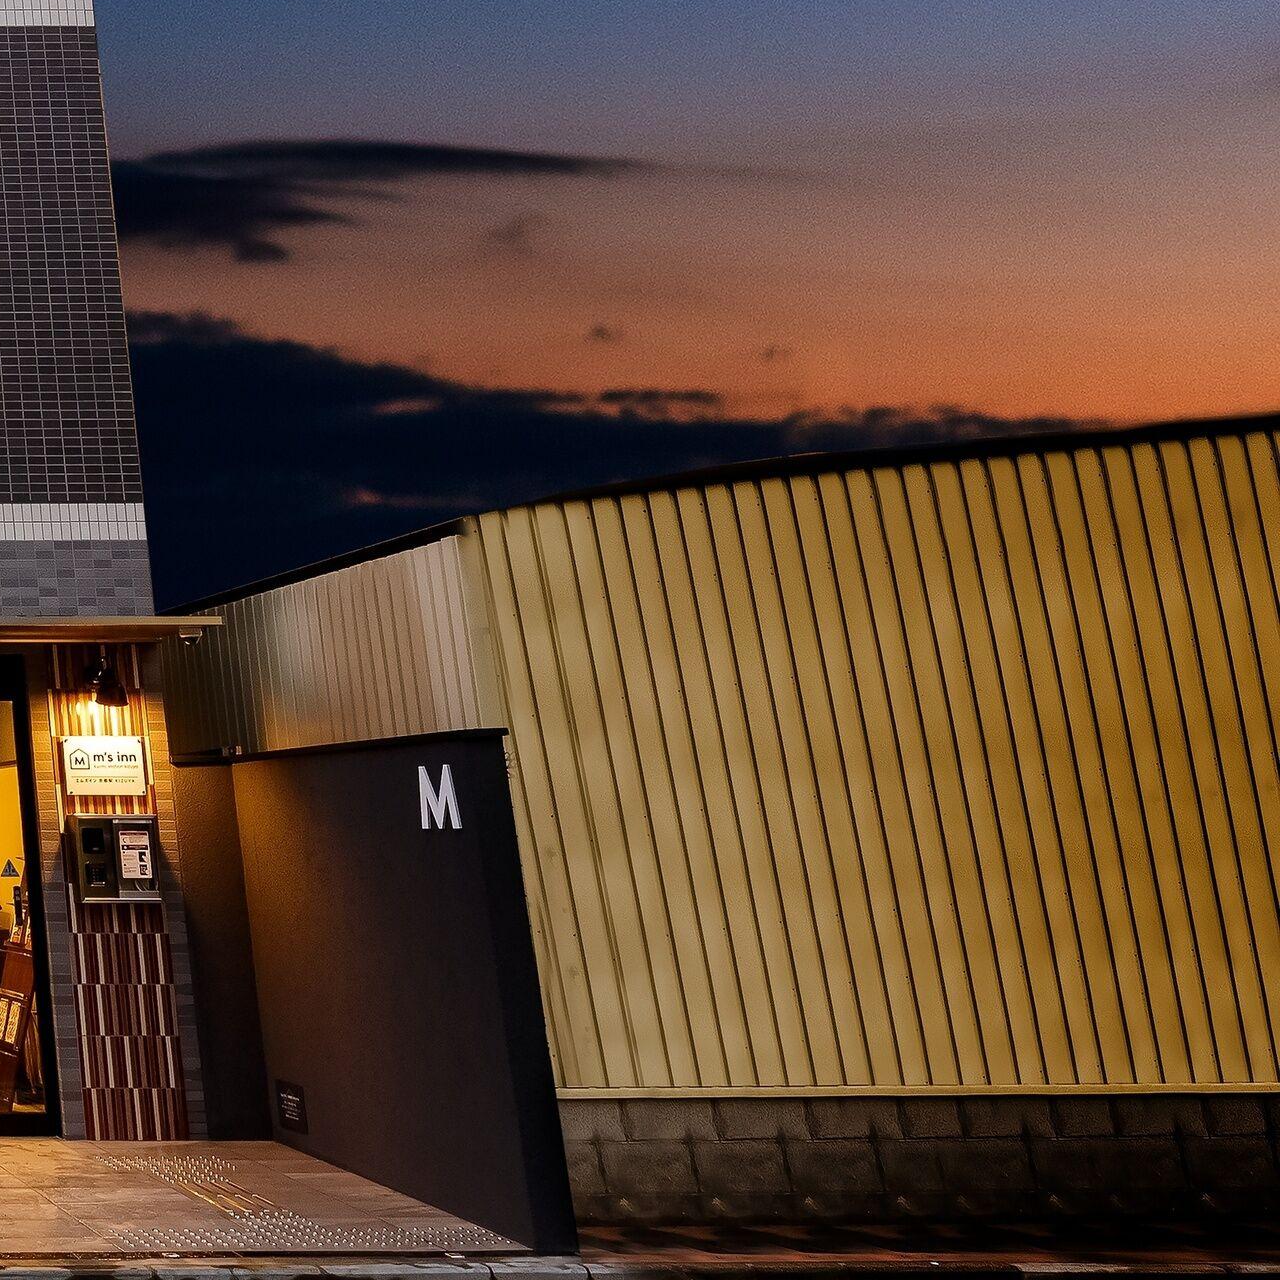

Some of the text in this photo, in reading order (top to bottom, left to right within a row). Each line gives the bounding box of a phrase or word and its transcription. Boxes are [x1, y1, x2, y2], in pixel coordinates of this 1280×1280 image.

[74, 757, 86, 766] M
[93, 752, 137, 762] m's inn
[418, 764, 462, 829] M
